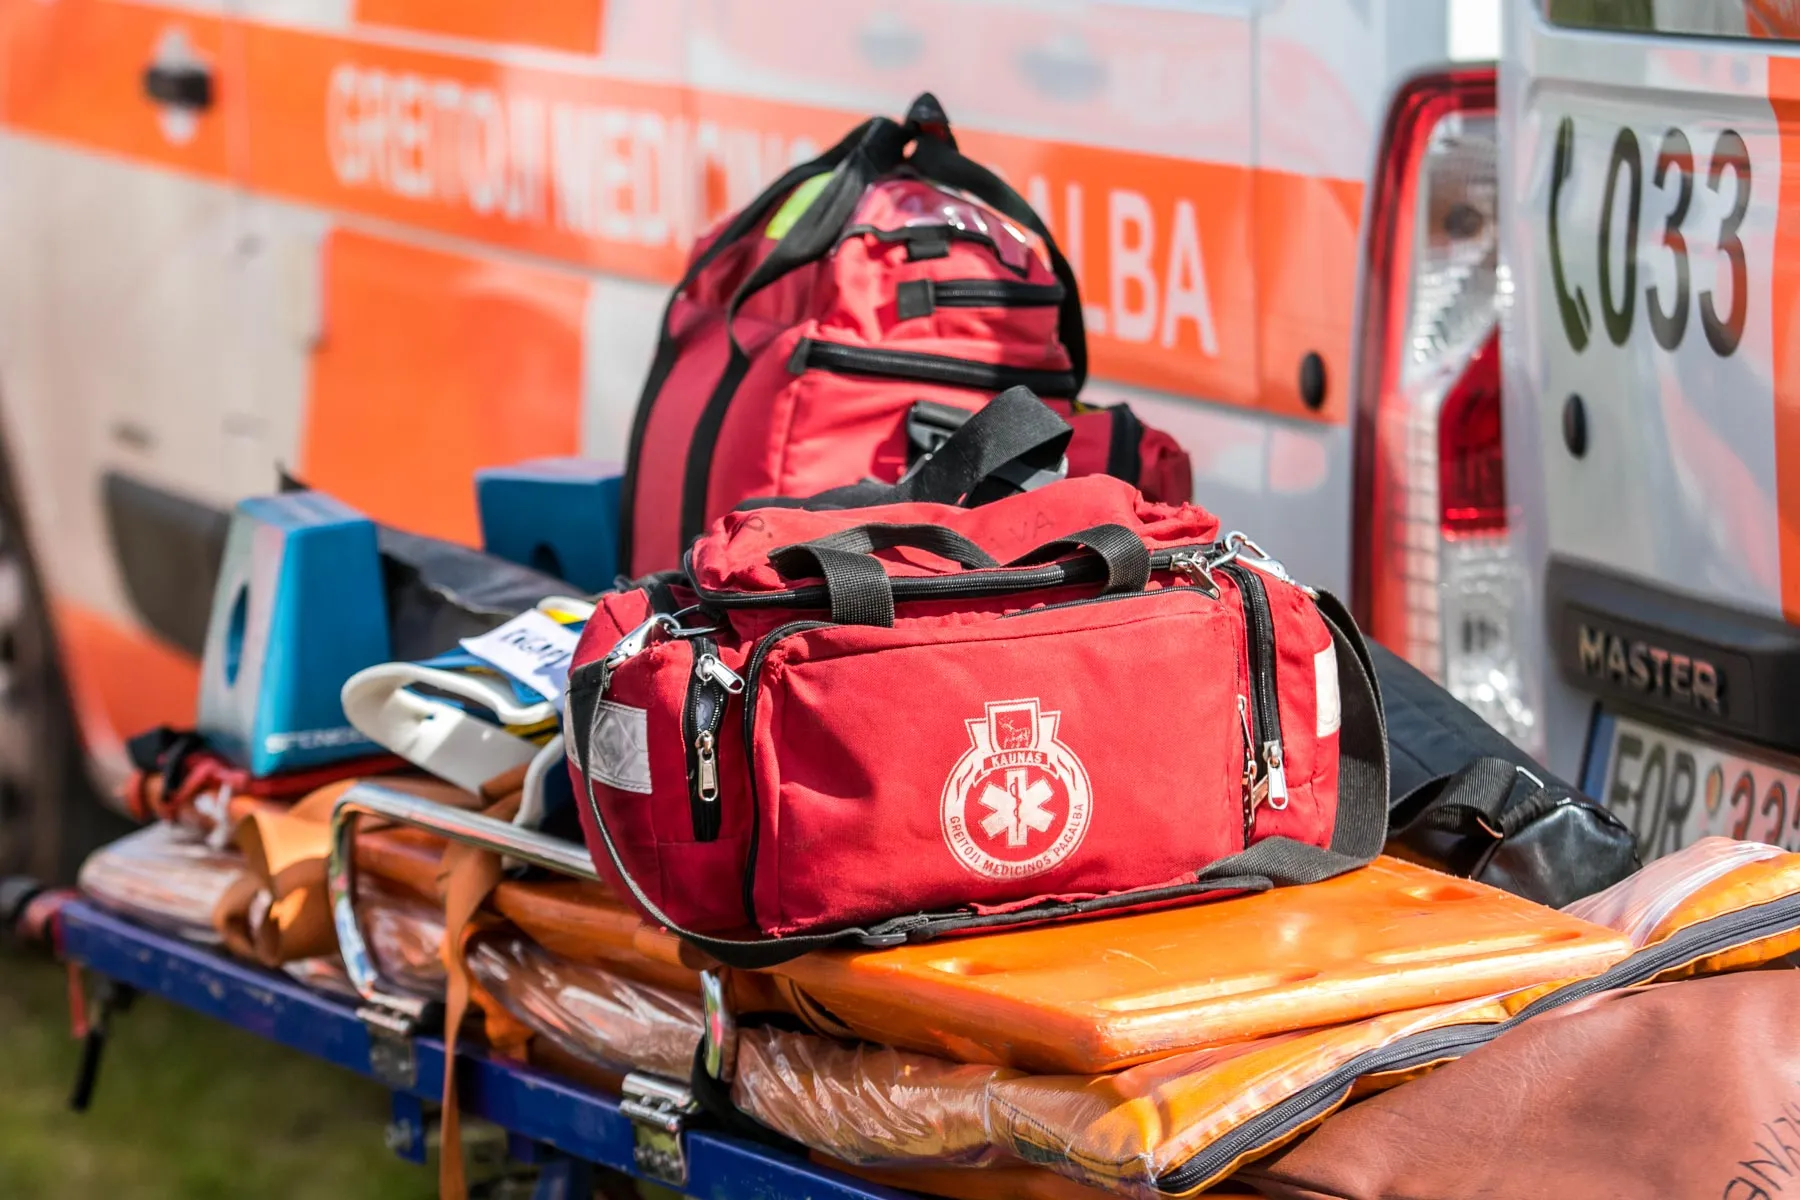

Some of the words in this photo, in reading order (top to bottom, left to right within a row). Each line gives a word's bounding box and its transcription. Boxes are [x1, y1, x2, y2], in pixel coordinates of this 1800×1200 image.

[1598, 126, 1752, 358] 033
[1577, 624, 1721, 715] MASTER
[991, 752, 1042, 768] KAUNAS
[950, 815, 982, 865] GREITOJI
[982, 855, 1052, 876] MEDICINOS
[1053, 803, 1085, 858] PAGALBA
